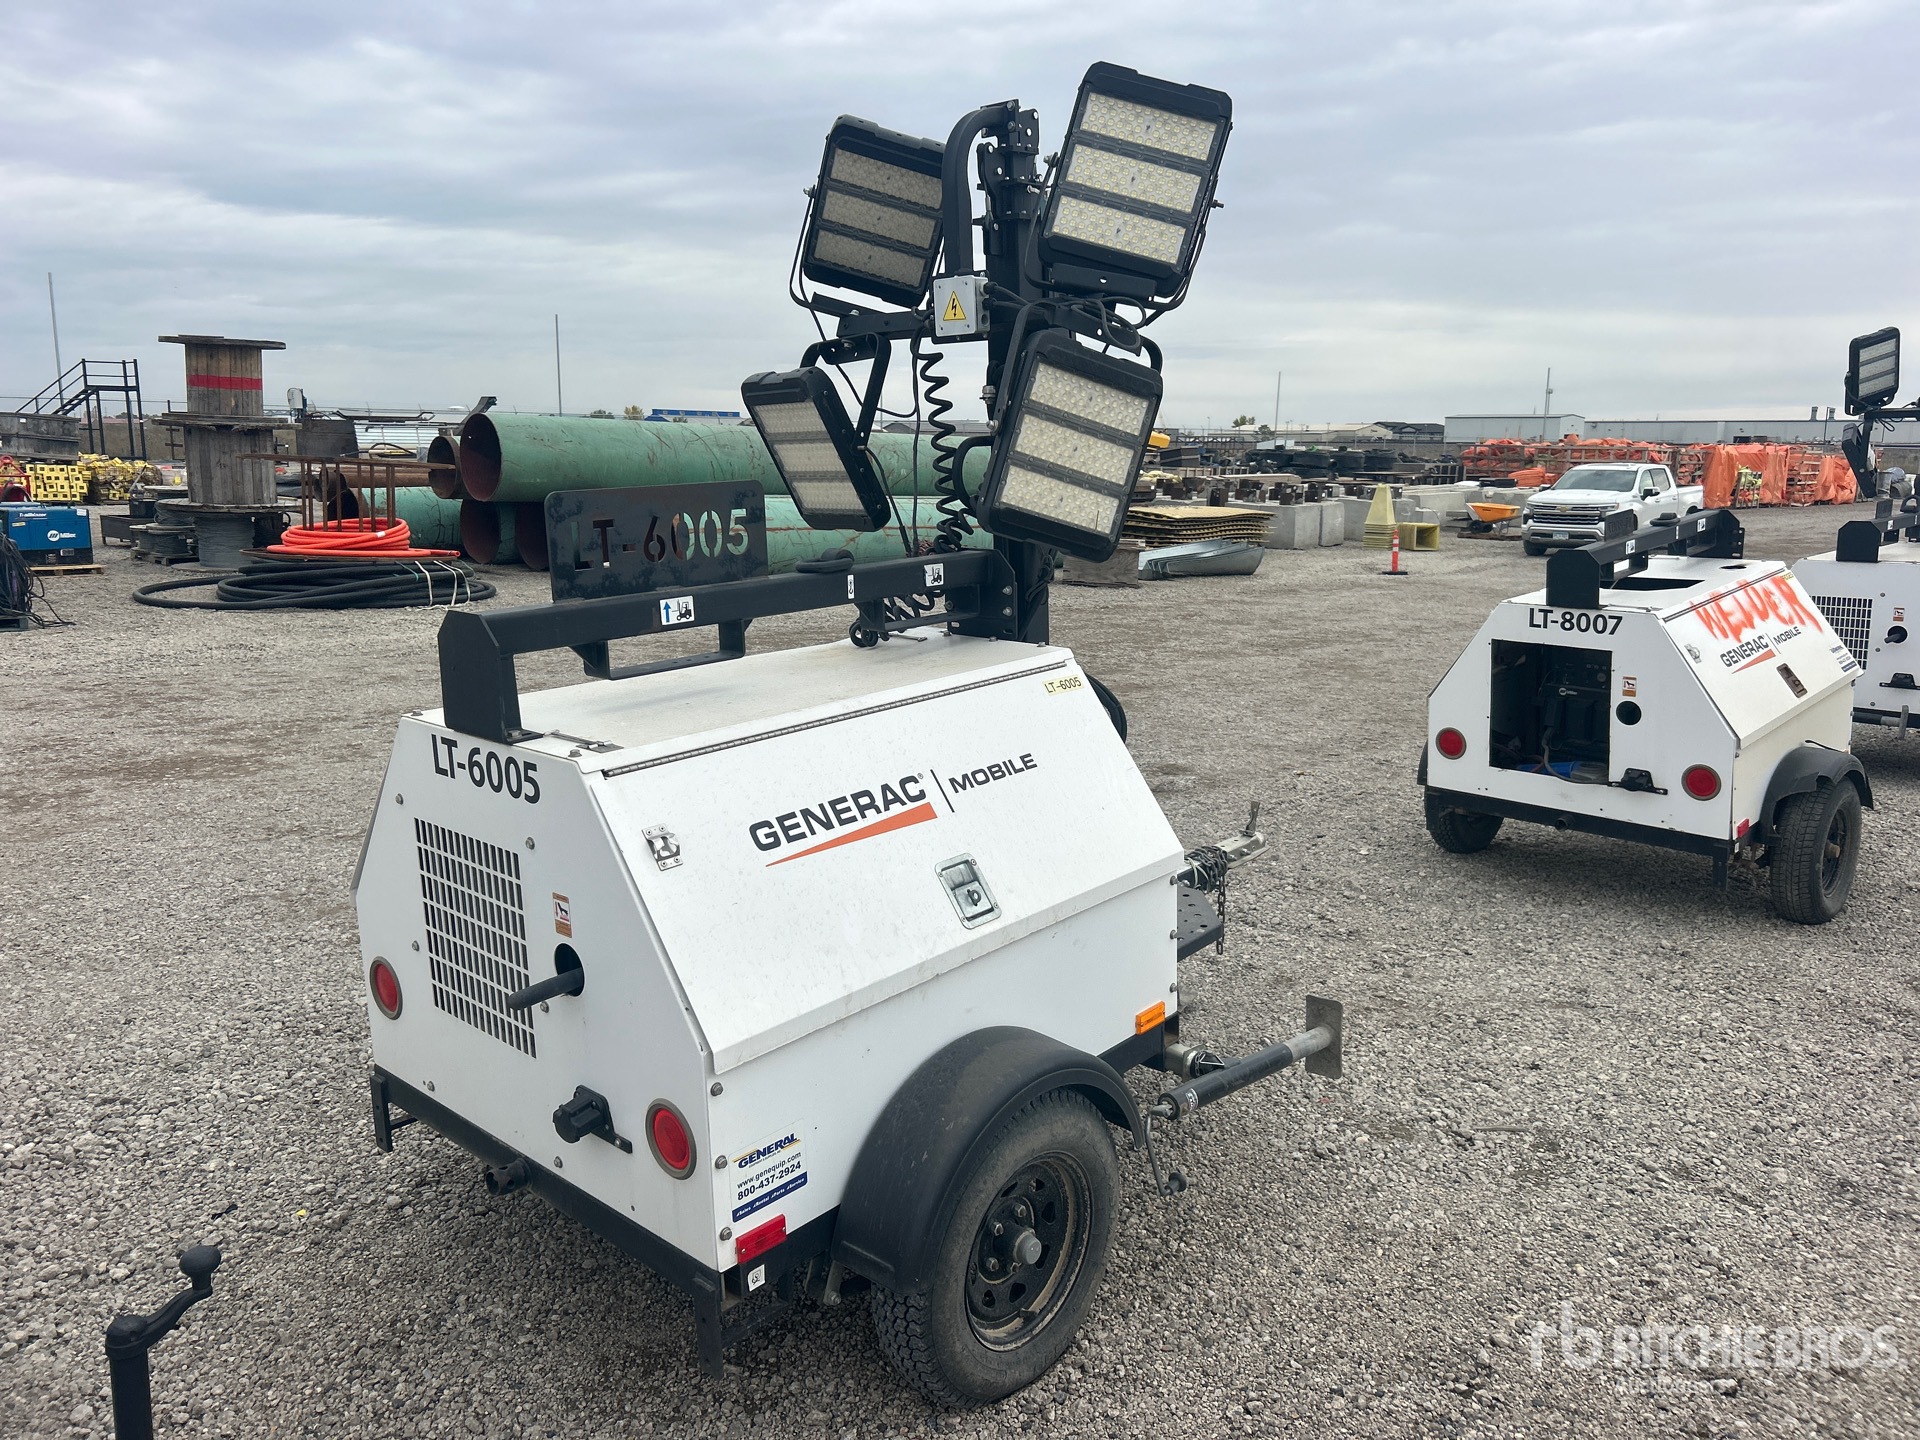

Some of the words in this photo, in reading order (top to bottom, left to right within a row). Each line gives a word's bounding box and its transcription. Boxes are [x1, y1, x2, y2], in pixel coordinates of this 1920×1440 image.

[571, 508, 749, 571] LT-6005
[1529, 607, 1623, 635] LT-8007
[1719, 635, 1770, 668] GENERAC
[1773, 625, 1802, 645] MOBILE
[1044, 676, 1082, 693] LT-6005
[431, 733, 541, 804] LT-6005
[948, 753, 1038, 794] MOBILE
[737, 1152, 802, 1189] www.genequip.com
[738, 1133, 798, 1169] GENERAL
[737, 1160, 802, 1201] 800-437-2924
